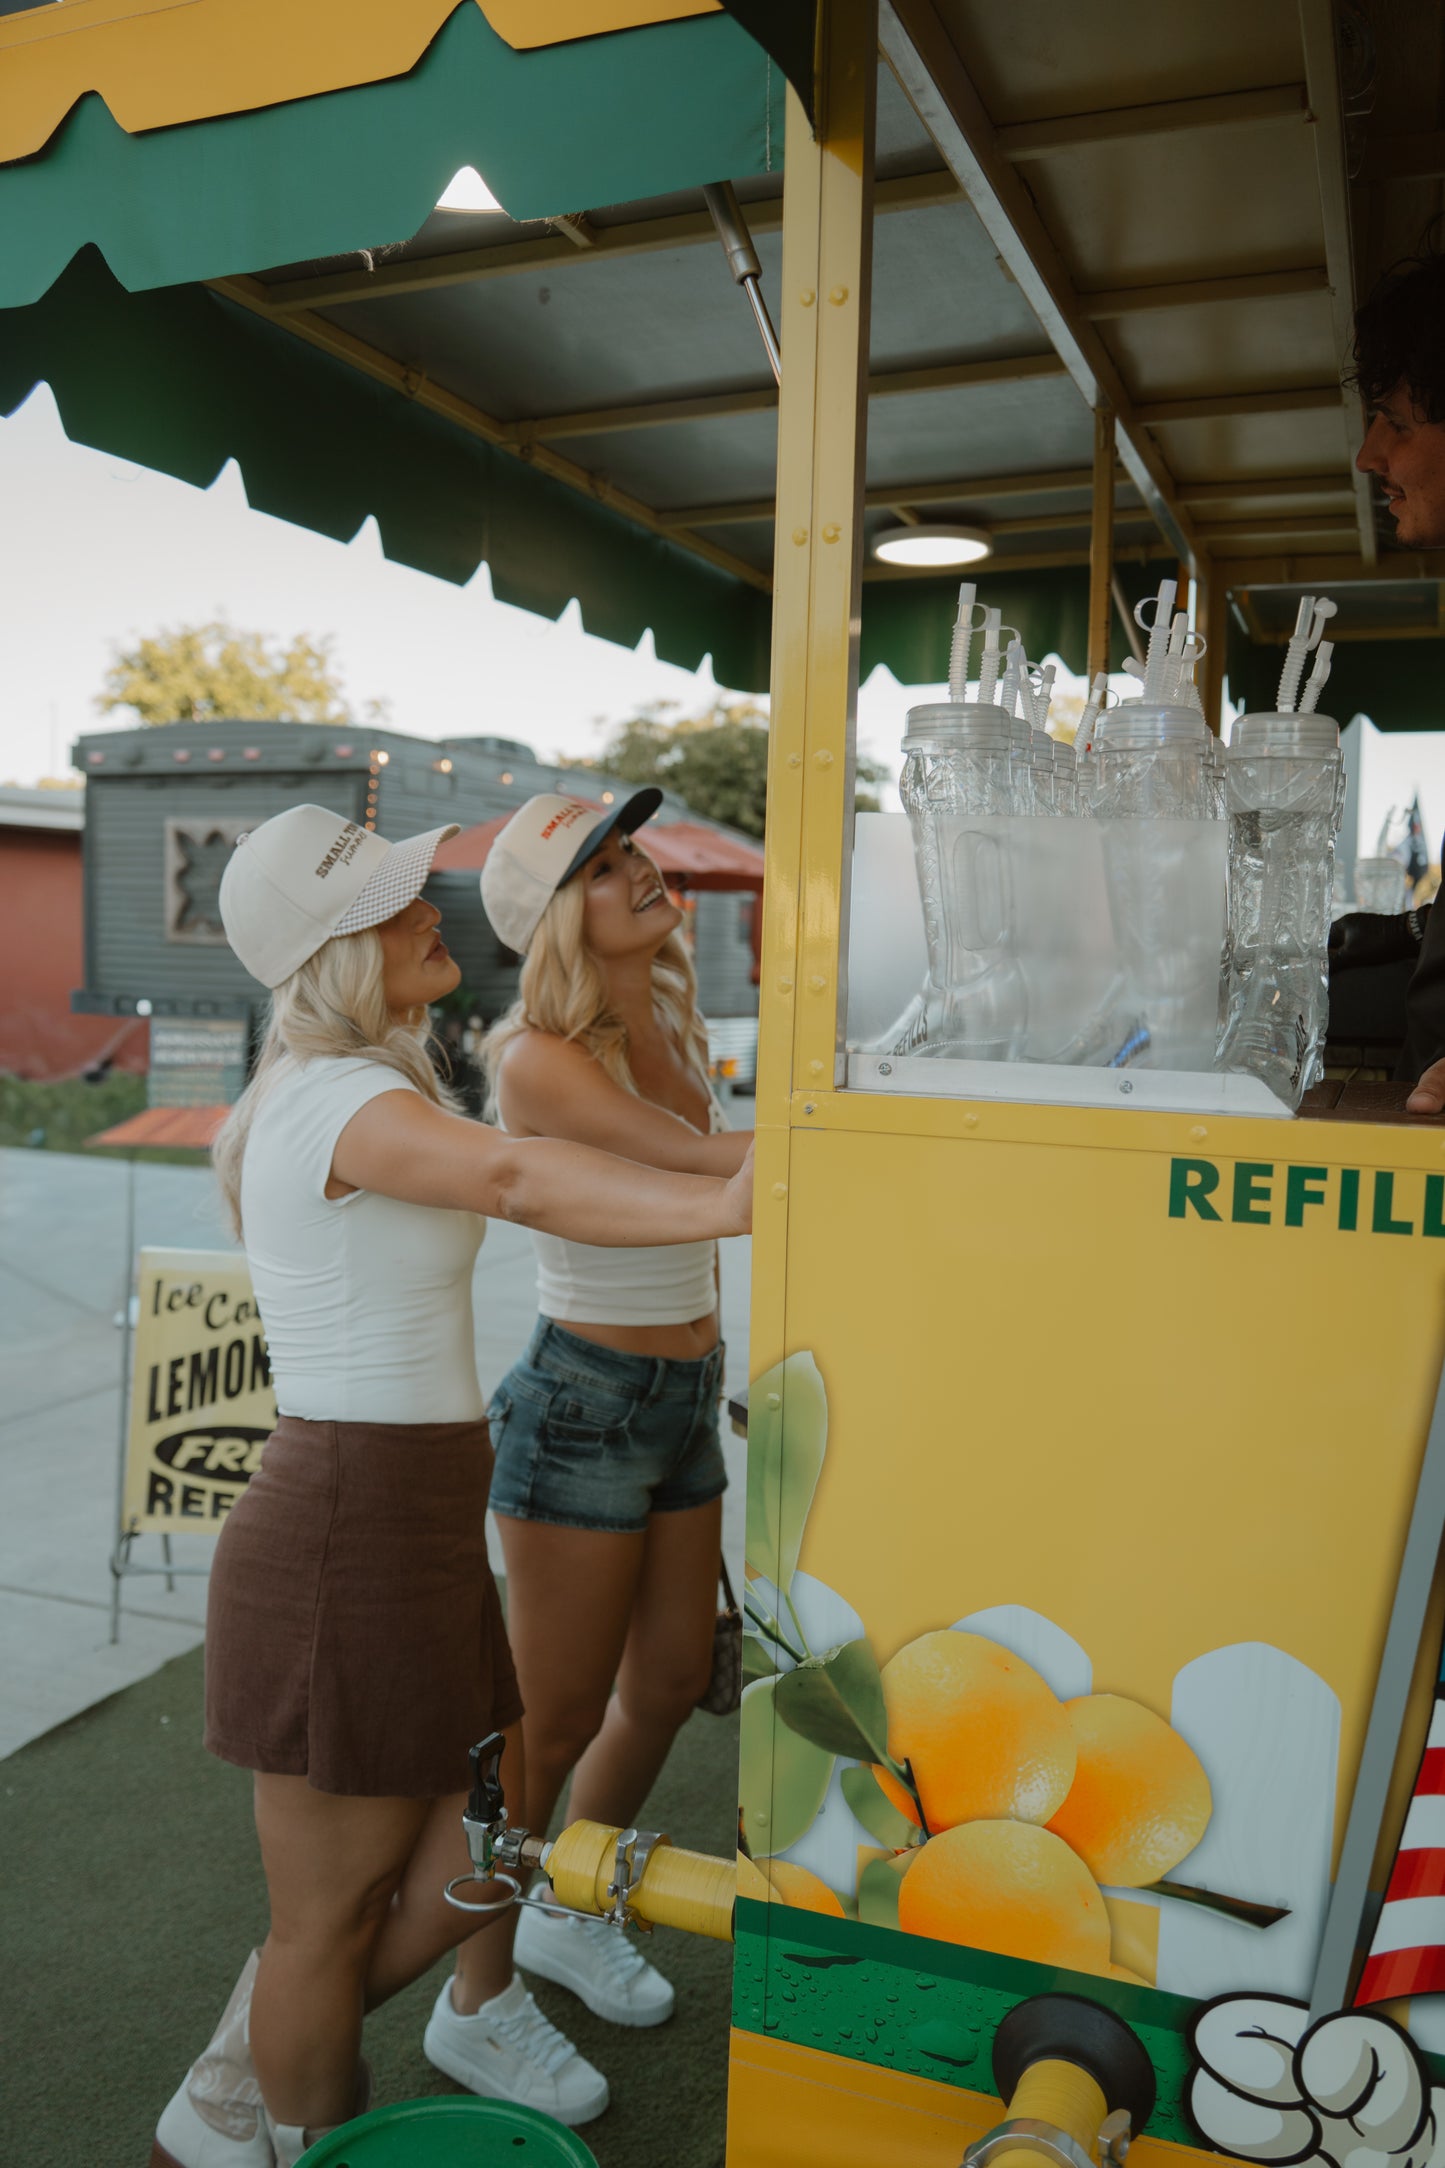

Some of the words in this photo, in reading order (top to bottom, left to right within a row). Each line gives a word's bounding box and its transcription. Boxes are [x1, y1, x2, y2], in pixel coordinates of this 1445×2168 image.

[315, 835, 351, 879] SMALL
[152, 1277, 204, 1317] Ice
[147, 1333, 271, 1423] LEMON
[171, 1435, 265, 1473] FRE
[147, 1469, 235, 1518] REF
